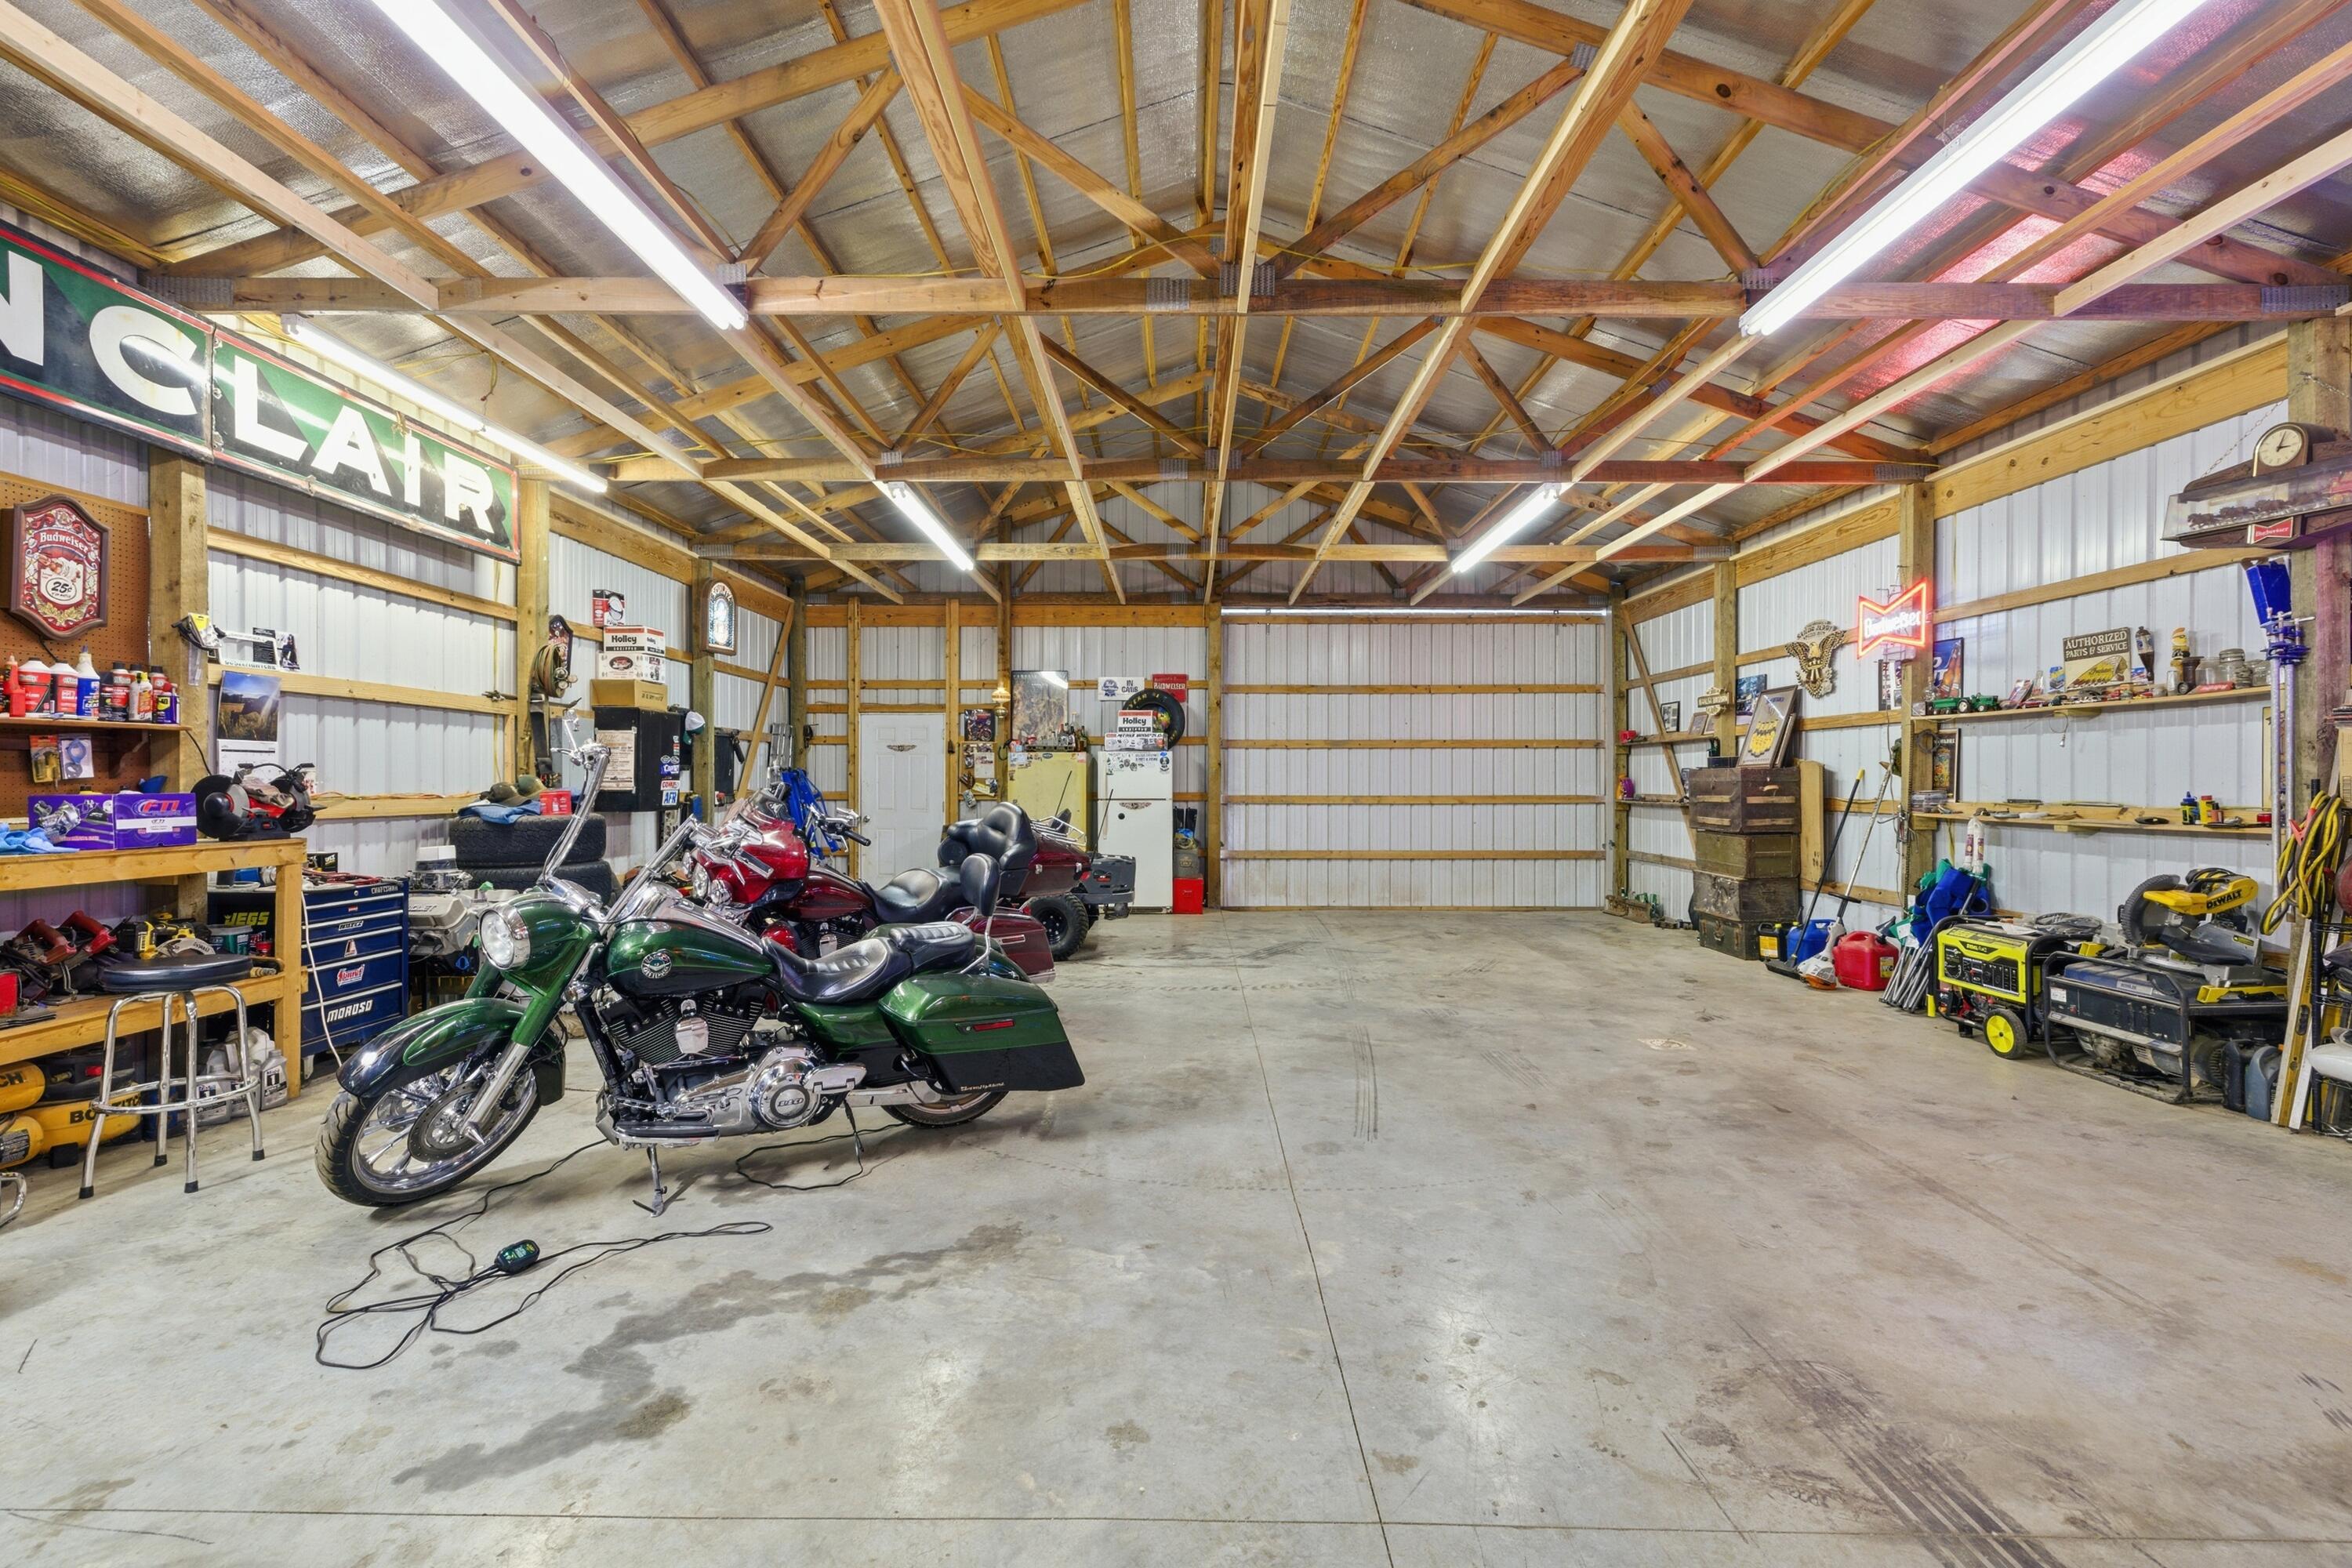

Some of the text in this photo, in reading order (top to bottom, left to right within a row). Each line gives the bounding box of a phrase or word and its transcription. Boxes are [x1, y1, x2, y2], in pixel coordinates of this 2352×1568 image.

[40, 532, 89, 553] Budweiser
[612, 635, 637, 644] Holley
[2065, 630, 2127, 650] AUTHORIZED
[2066, 648, 2088, 659] PARTS
[2096, 642, 2128, 653] SERVICE
[1123, 717, 1147, 726] Holley
[2207, 888, 2242, 909] DEWALT
[224, 911, 270, 926] JEGS
[327, 999, 373, 1023] MOROSO
